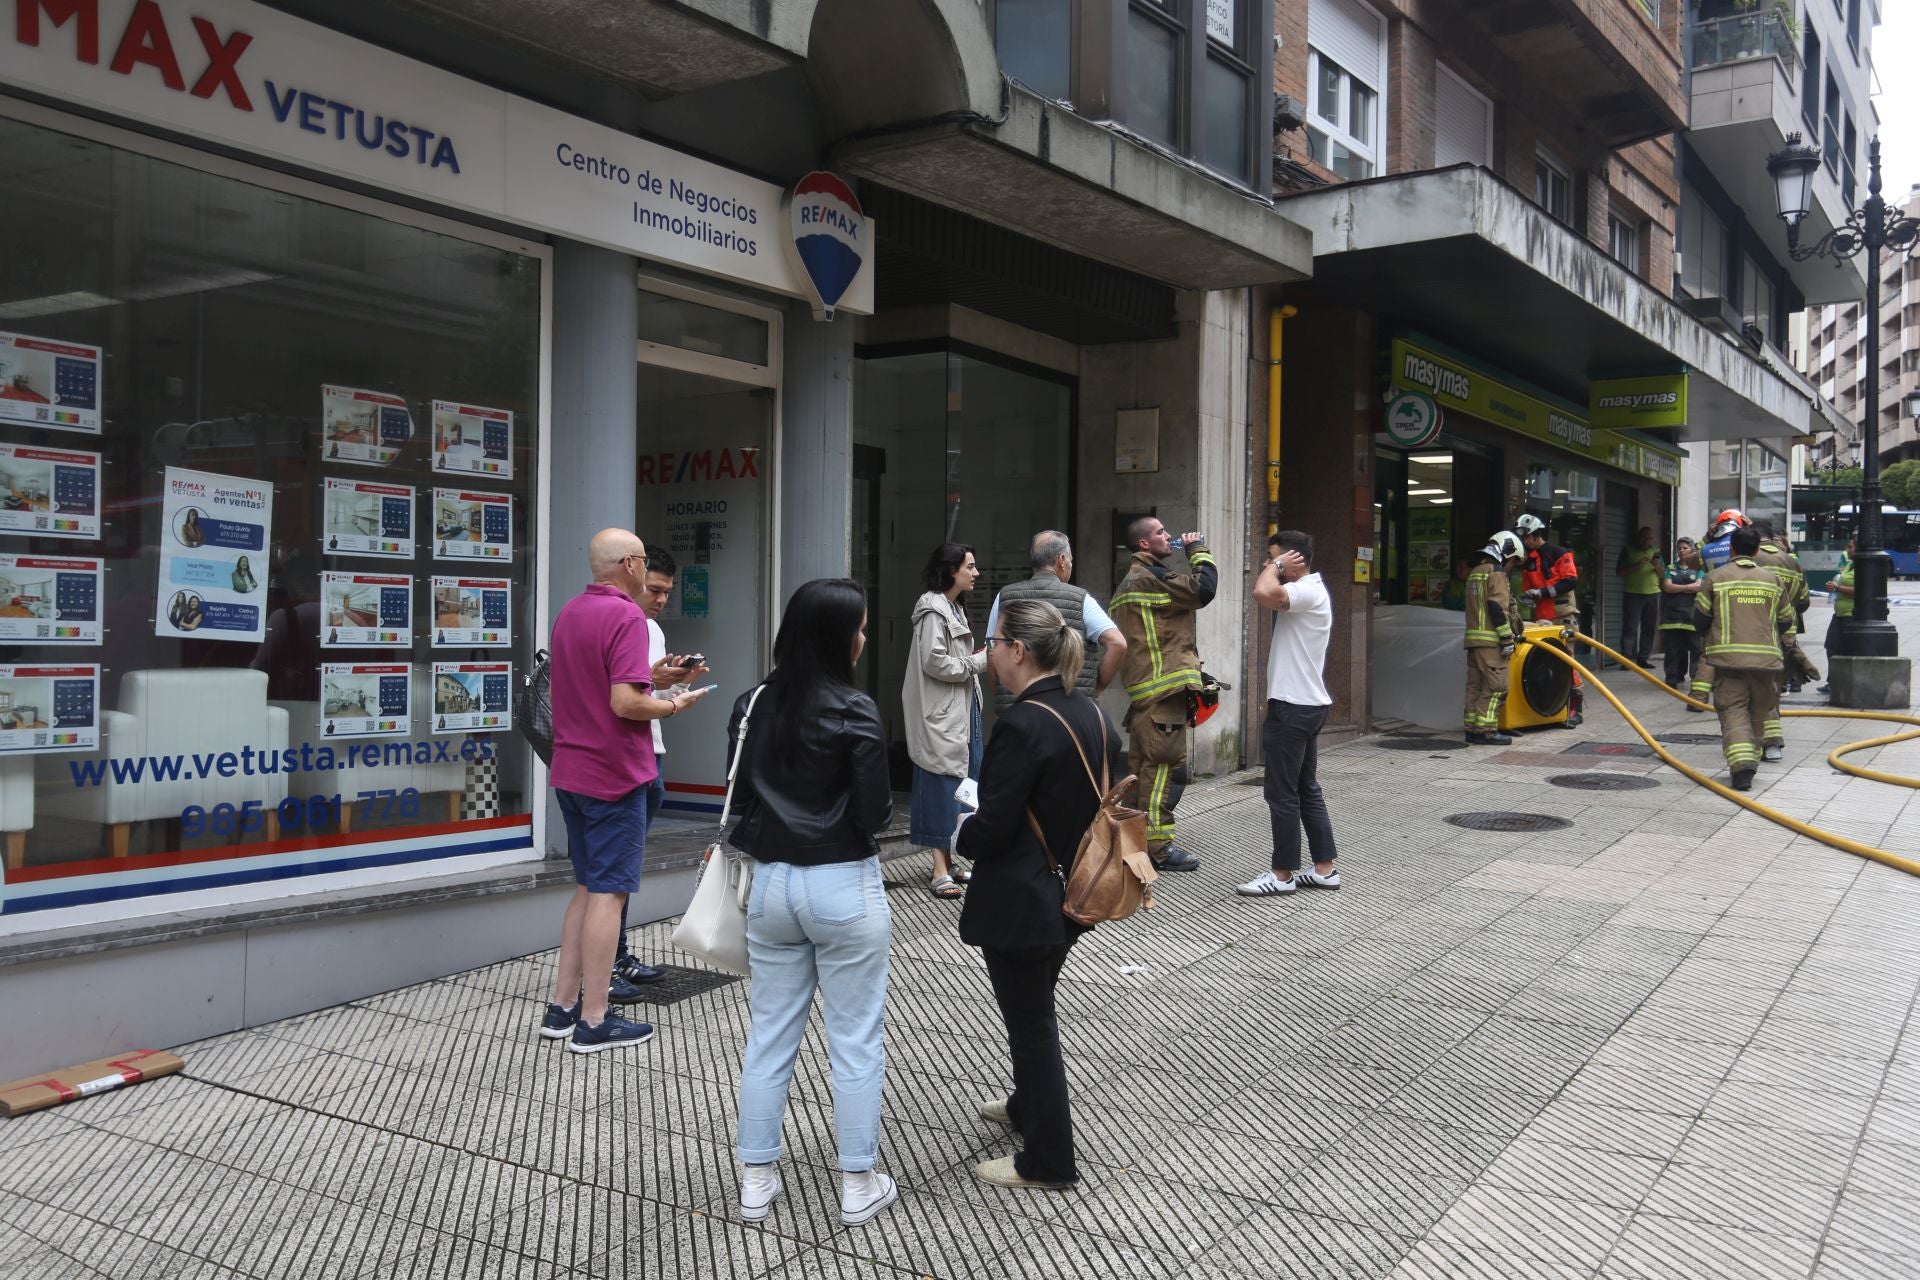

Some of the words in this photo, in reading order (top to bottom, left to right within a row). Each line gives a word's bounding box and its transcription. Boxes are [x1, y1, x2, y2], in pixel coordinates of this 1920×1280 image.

[264, 80, 461, 175] VETUSTA
[557, 143, 630, 184] Centro
[637, 170, 662, 195] de
[670, 178, 757, 225] Negocios
[633, 201, 757, 256] Inmobiliarios
[801, 205, 858, 240] RE/MAX
[1404, 353, 1469, 400] masymas
[1599, 392, 1677, 408] masymas
[1548, 413, 1591, 447] masymas
[639, 447, 760, 485] RE/MAX
[172, 480, 206, 491] RE/MAX
[172, 488, 206, 498] VETUSTA
[214, 488, 245, 499] Agentes
[214, 496, 226, 505] en
[229, 498, 261, 510] ventas
[667, 500, 728, 516] HORARIO
[1729, 589, 1773, 598] BOMBEROS
[69, 736, 494, 788] www.vetusta.remax.es
[181, 800, 263, 839] 985
[277, 793, 342, 830] 061
[357, 787, 421, 823] 778
